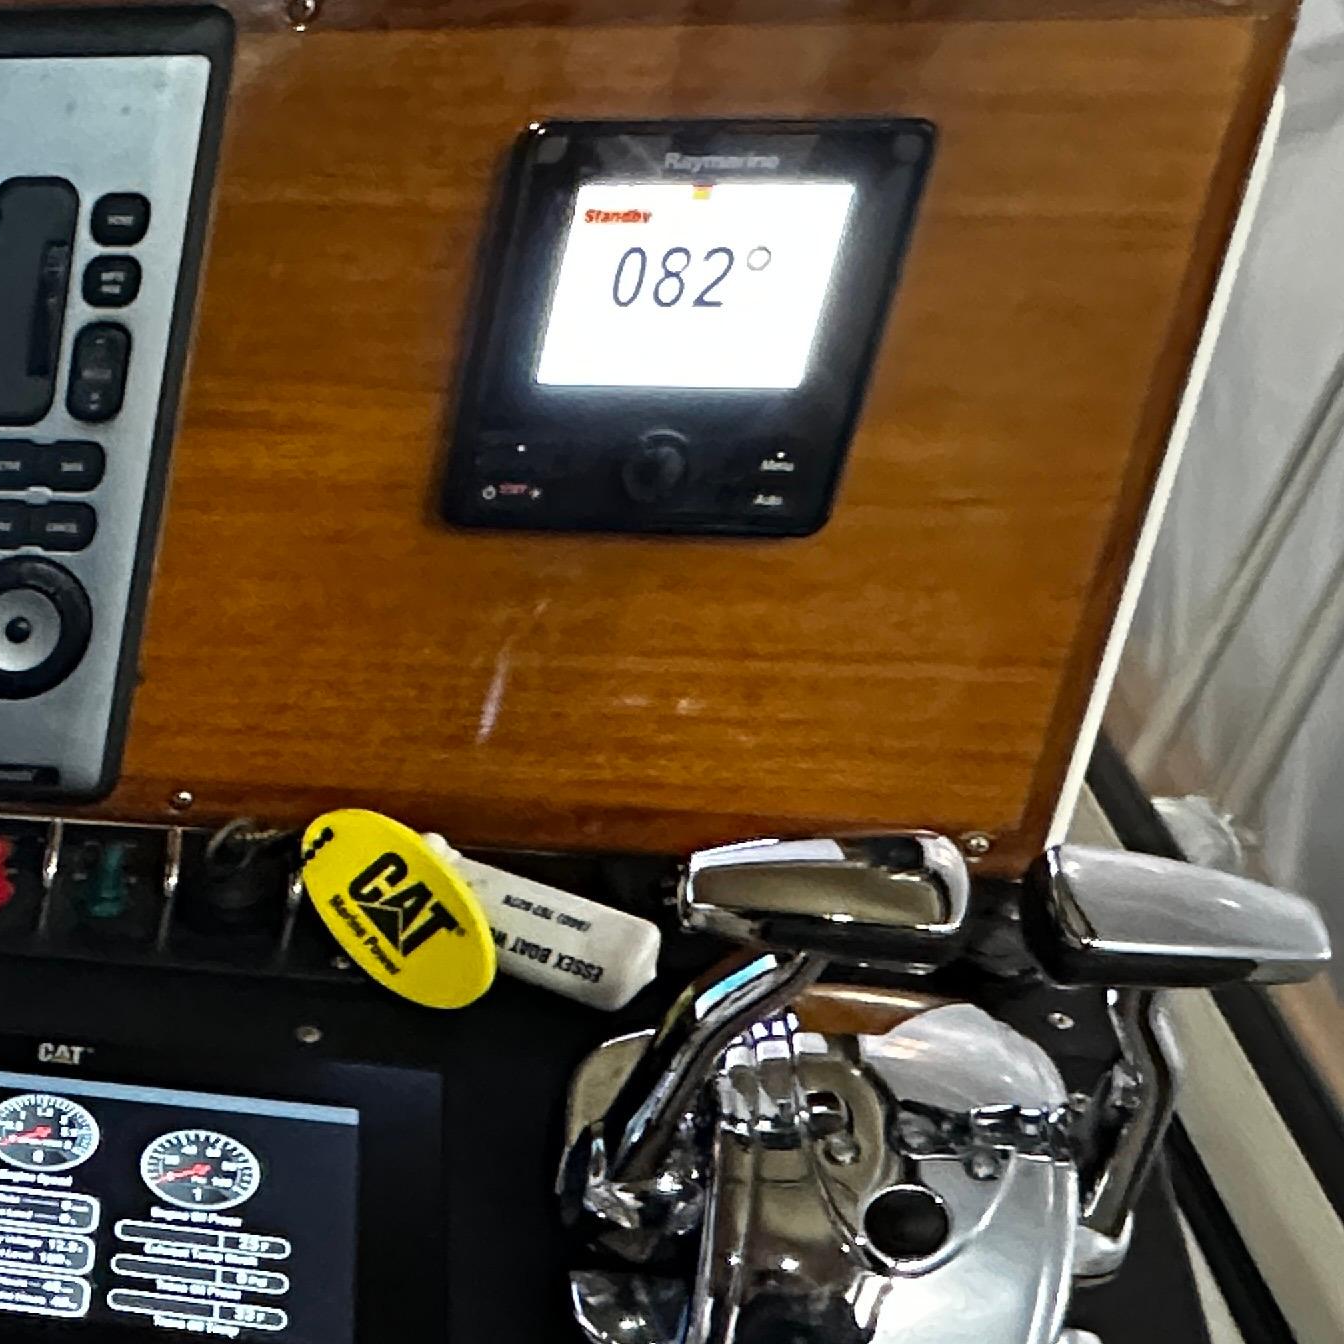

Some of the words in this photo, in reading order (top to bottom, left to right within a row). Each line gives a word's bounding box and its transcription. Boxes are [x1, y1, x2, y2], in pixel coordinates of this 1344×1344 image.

[664, 152, 780, 173] Raymarine
[584, 209, 652, 224] Standby
[347, 851, 459, 958] CAT
[554, 952, 604, 984] ESSEX
[38, 1041, 85, 1065] CAT
